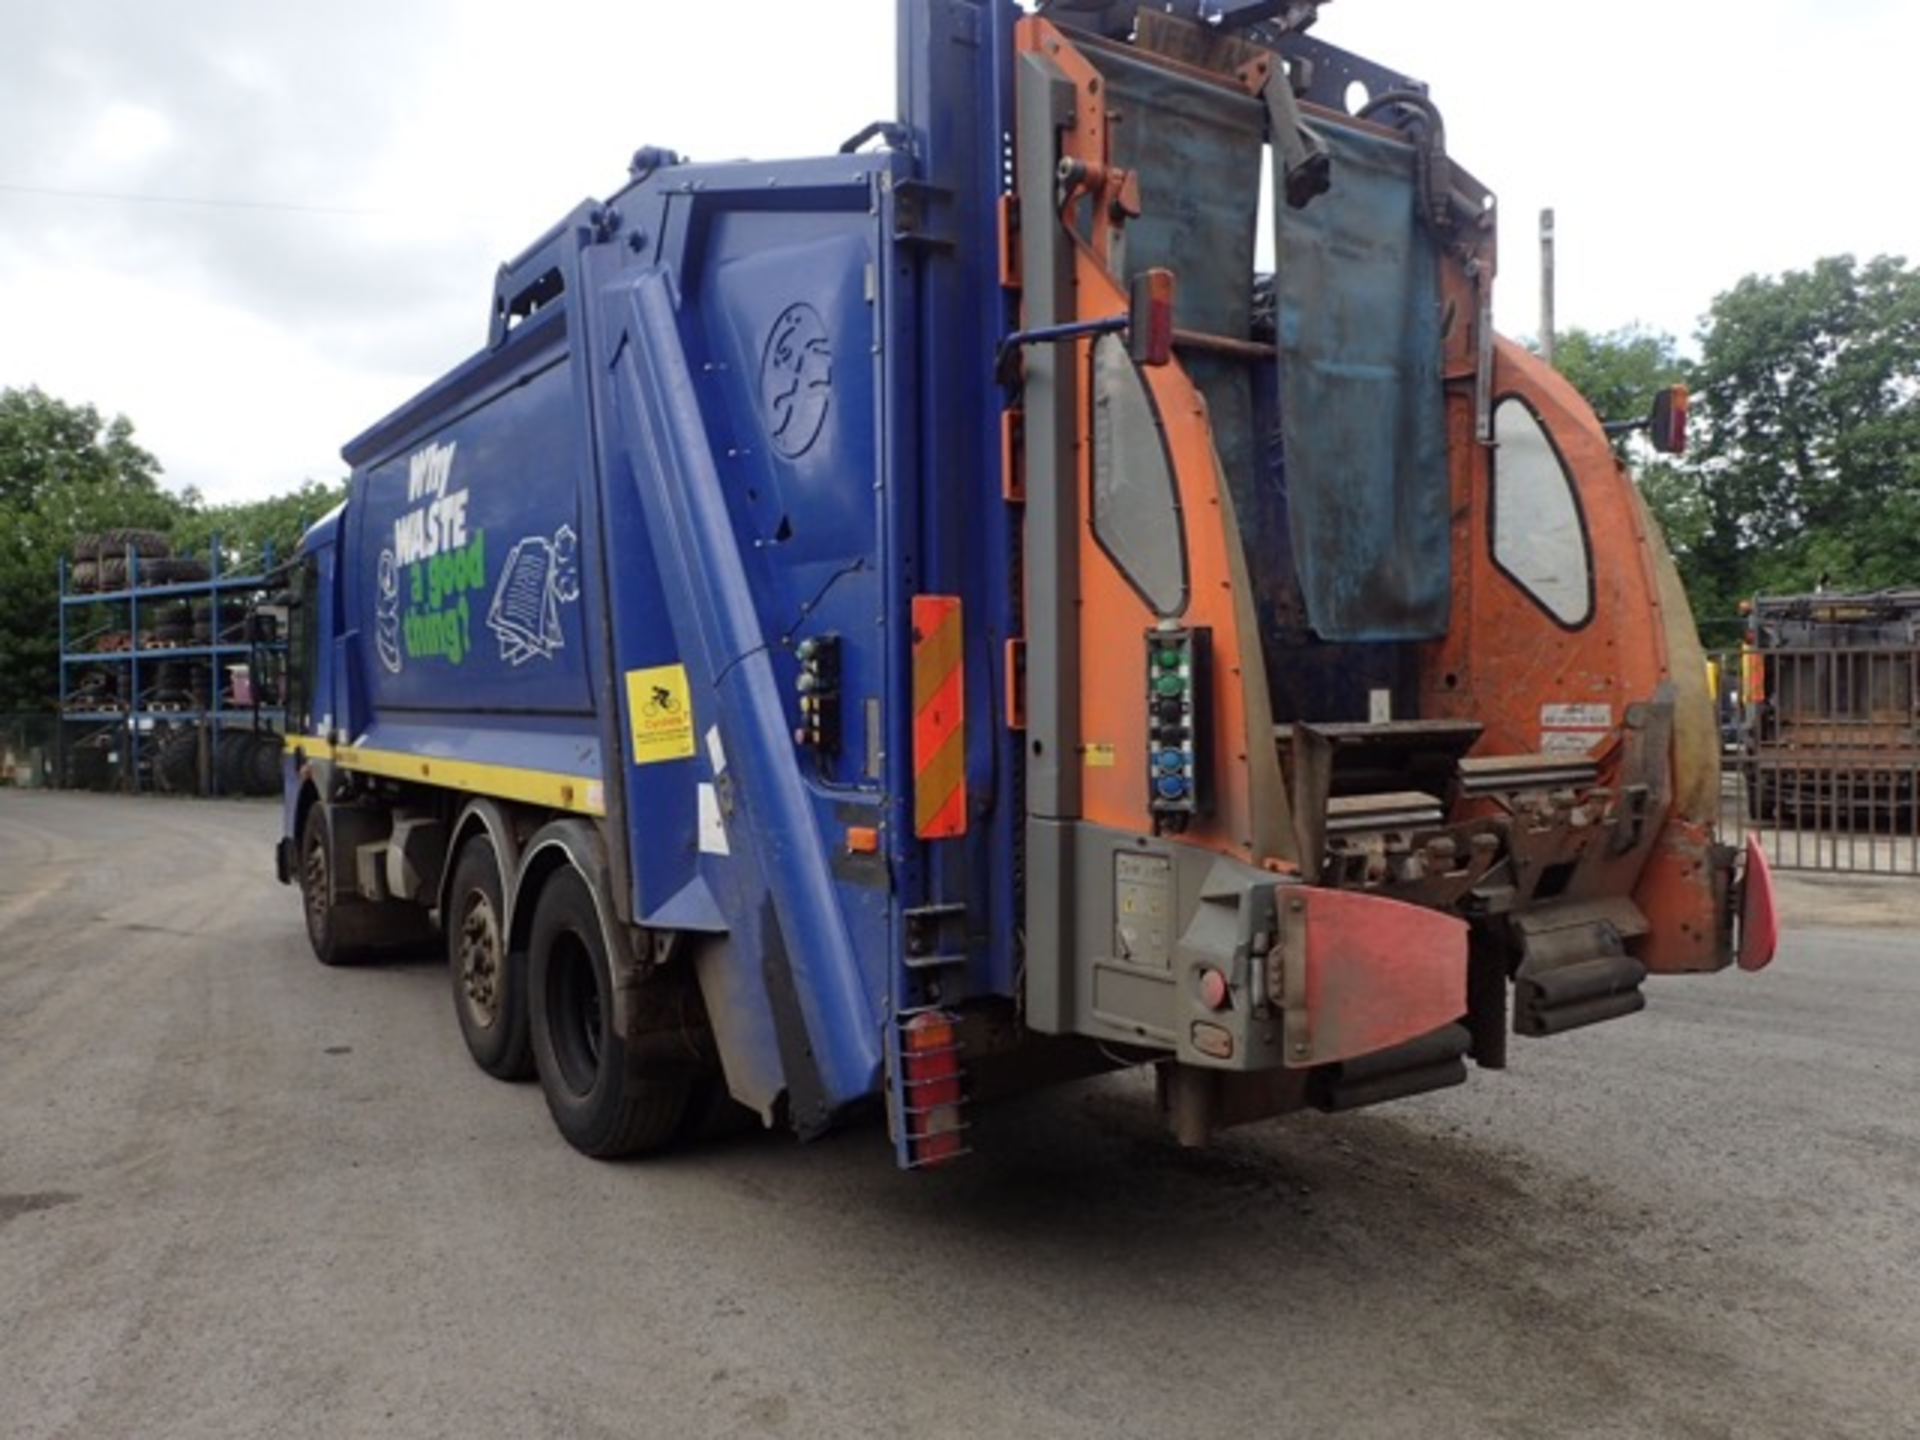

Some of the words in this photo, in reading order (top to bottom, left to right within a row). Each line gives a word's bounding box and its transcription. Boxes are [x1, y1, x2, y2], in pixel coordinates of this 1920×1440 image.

[395, 488, 469, 568] WASTE
[411, 561, 422, 602] a
[429, 527, 485, 609] good
